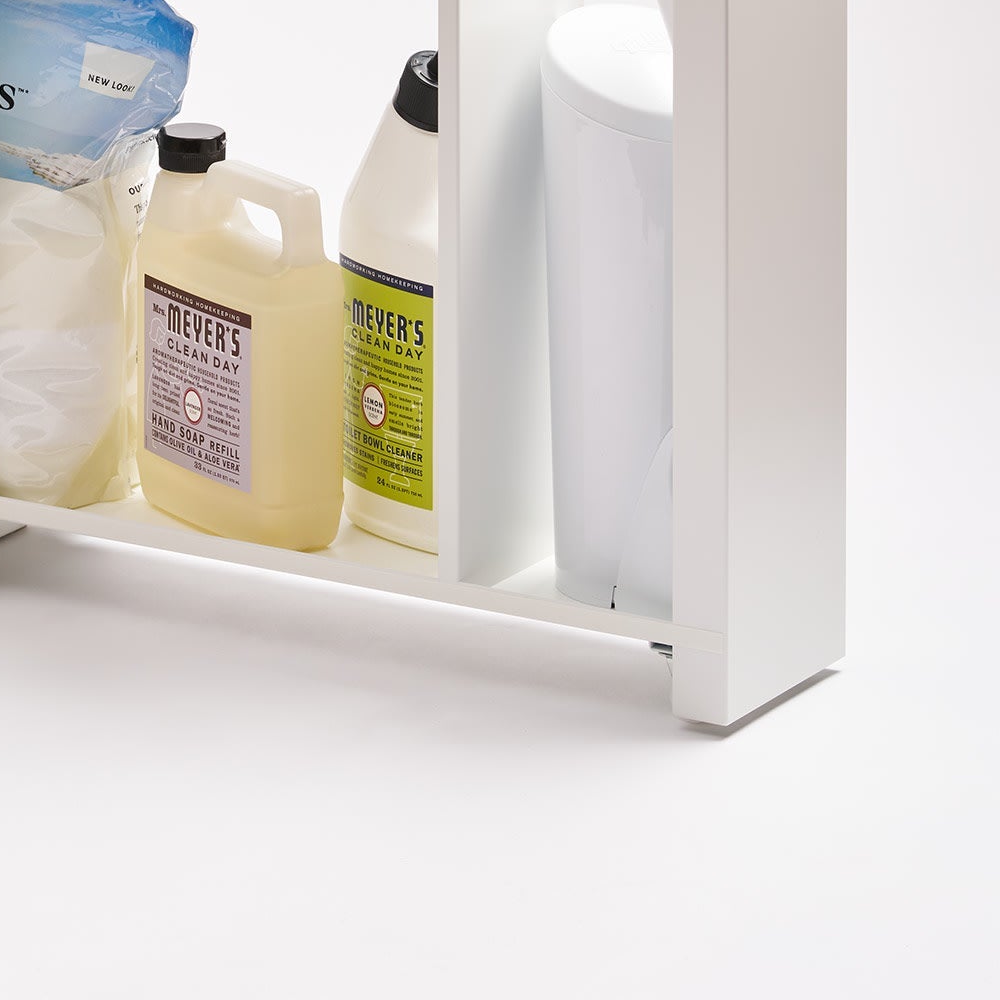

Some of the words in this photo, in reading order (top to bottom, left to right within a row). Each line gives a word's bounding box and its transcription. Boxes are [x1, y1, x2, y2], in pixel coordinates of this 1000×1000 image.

[88, 73, 110, 86] NEW
[377, 274, 424, 292] HOMEKEEPING
[152, 303, 166, 317] Mrs.
[153, 283, 194, 305] HARDWORKING
[195, 301, 240, 322] HOMEKEEPING
[167, 338, 208, 364] CLEAN
[213, 356, 240, 375] DAY
[352, 328, 390, 351] CLEAN
[395, 344, 423, 361] DAY
[364, 396, 383, 408] LEMON
[152, 412, 175, 433] HAND
[179, 426, 205, 446] SOAP
[209, 440, 240, 460] REFILL
[363, 434, 385, 451] BOWL
[386, 444, 423, 462] CLEANER
[168, 437, 185, 451] OLIVE
[186, 445, 196, 456] OIL
[197, 450, 203, 458] &
[204, 452, 220, 466] ALOE
[222, 459, 240, 472] VERA
[376, 476, 386, 486] 24
